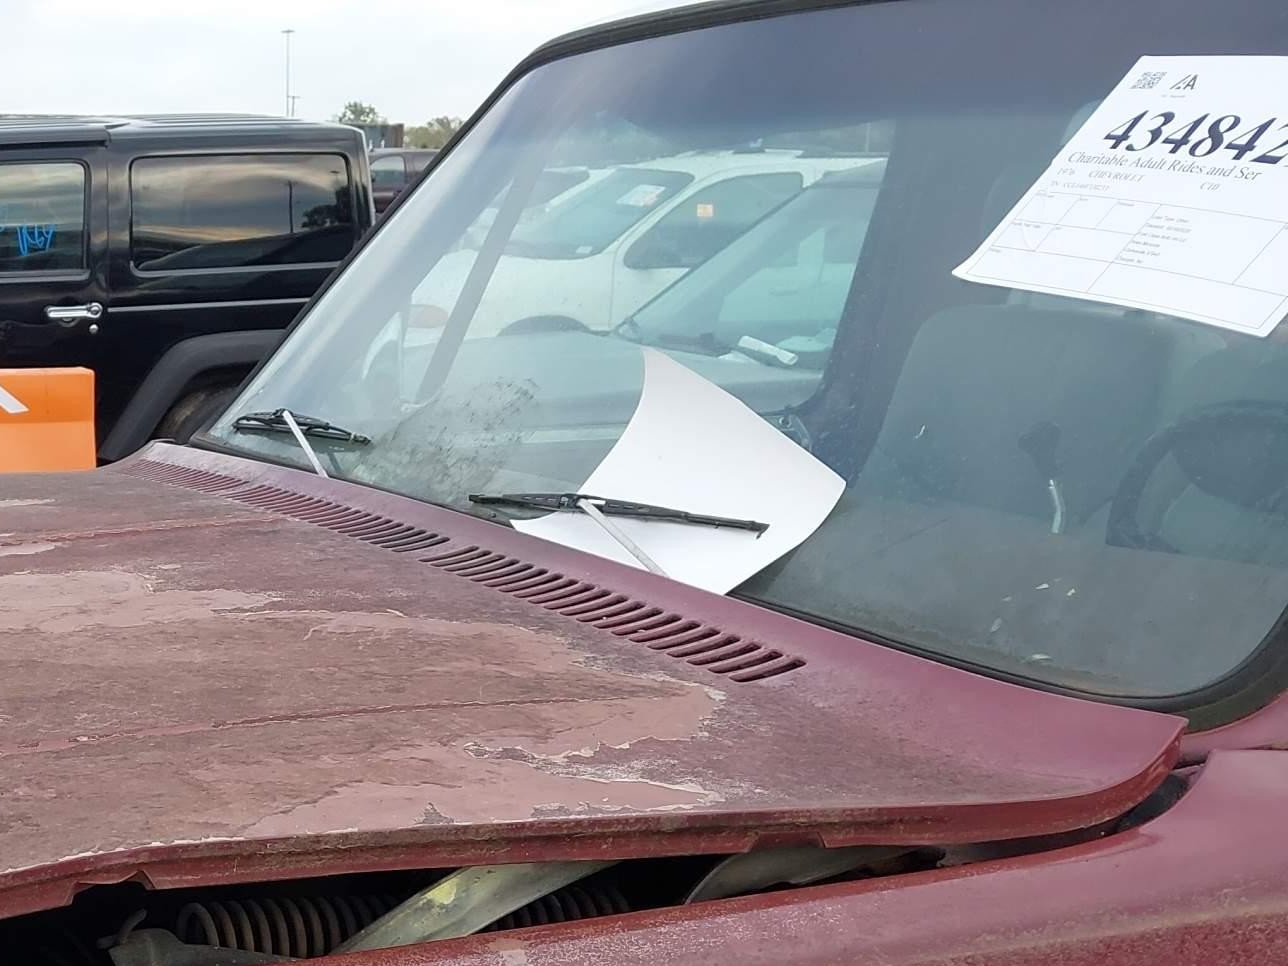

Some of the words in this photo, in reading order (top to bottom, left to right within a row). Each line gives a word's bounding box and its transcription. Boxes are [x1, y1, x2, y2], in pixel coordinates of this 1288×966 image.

[1103, 110, 1288, 168] 434842
[1067, 151, 1129, 167] Charitable
[1129, 158, 1166, 170] Adult
[1167, 160, 1204, 174] Rides
[1206, 164, 1233, 178] and
[1234, 166, 1263, 181] Ser
